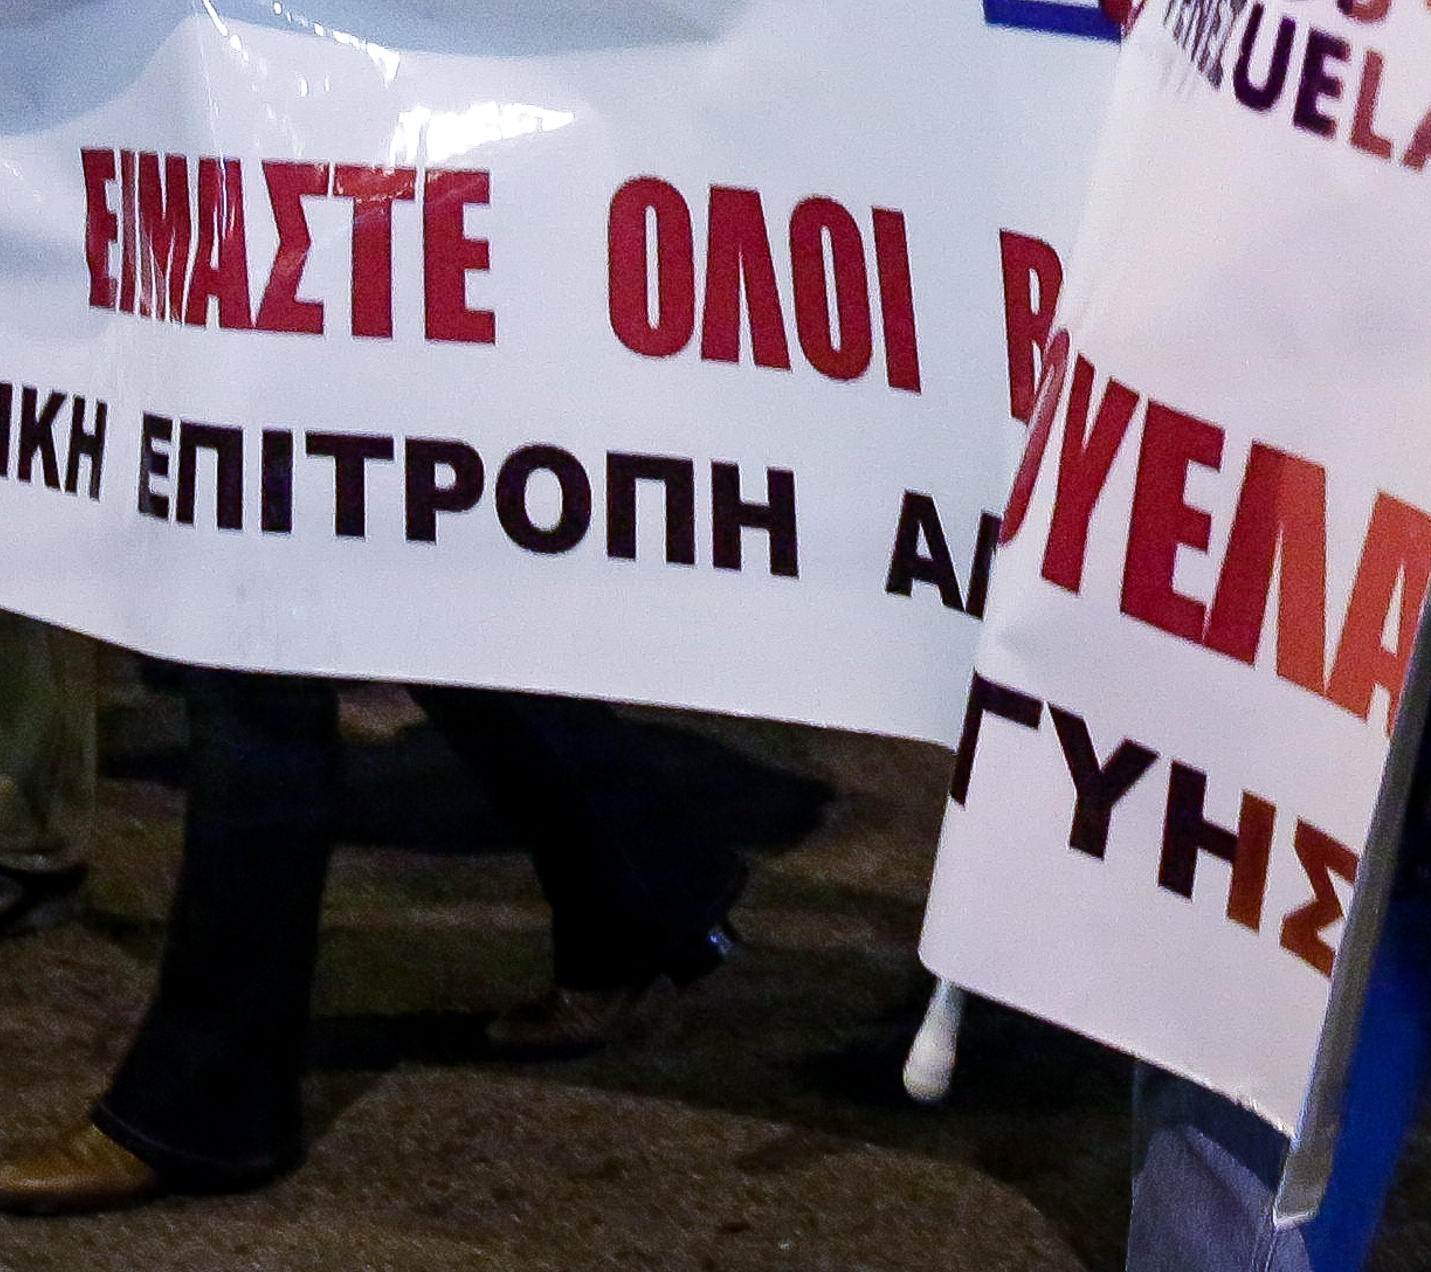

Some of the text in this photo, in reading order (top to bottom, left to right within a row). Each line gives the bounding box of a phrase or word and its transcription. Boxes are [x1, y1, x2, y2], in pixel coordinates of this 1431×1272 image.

[80, 146, 498, 346] ΕΙΜΑΣΤΕ
[607, 173, 923, 394] ΟΛΟΙ
[138, 408, 801, 579] ΕΠΙΤΡΟΠΗ
